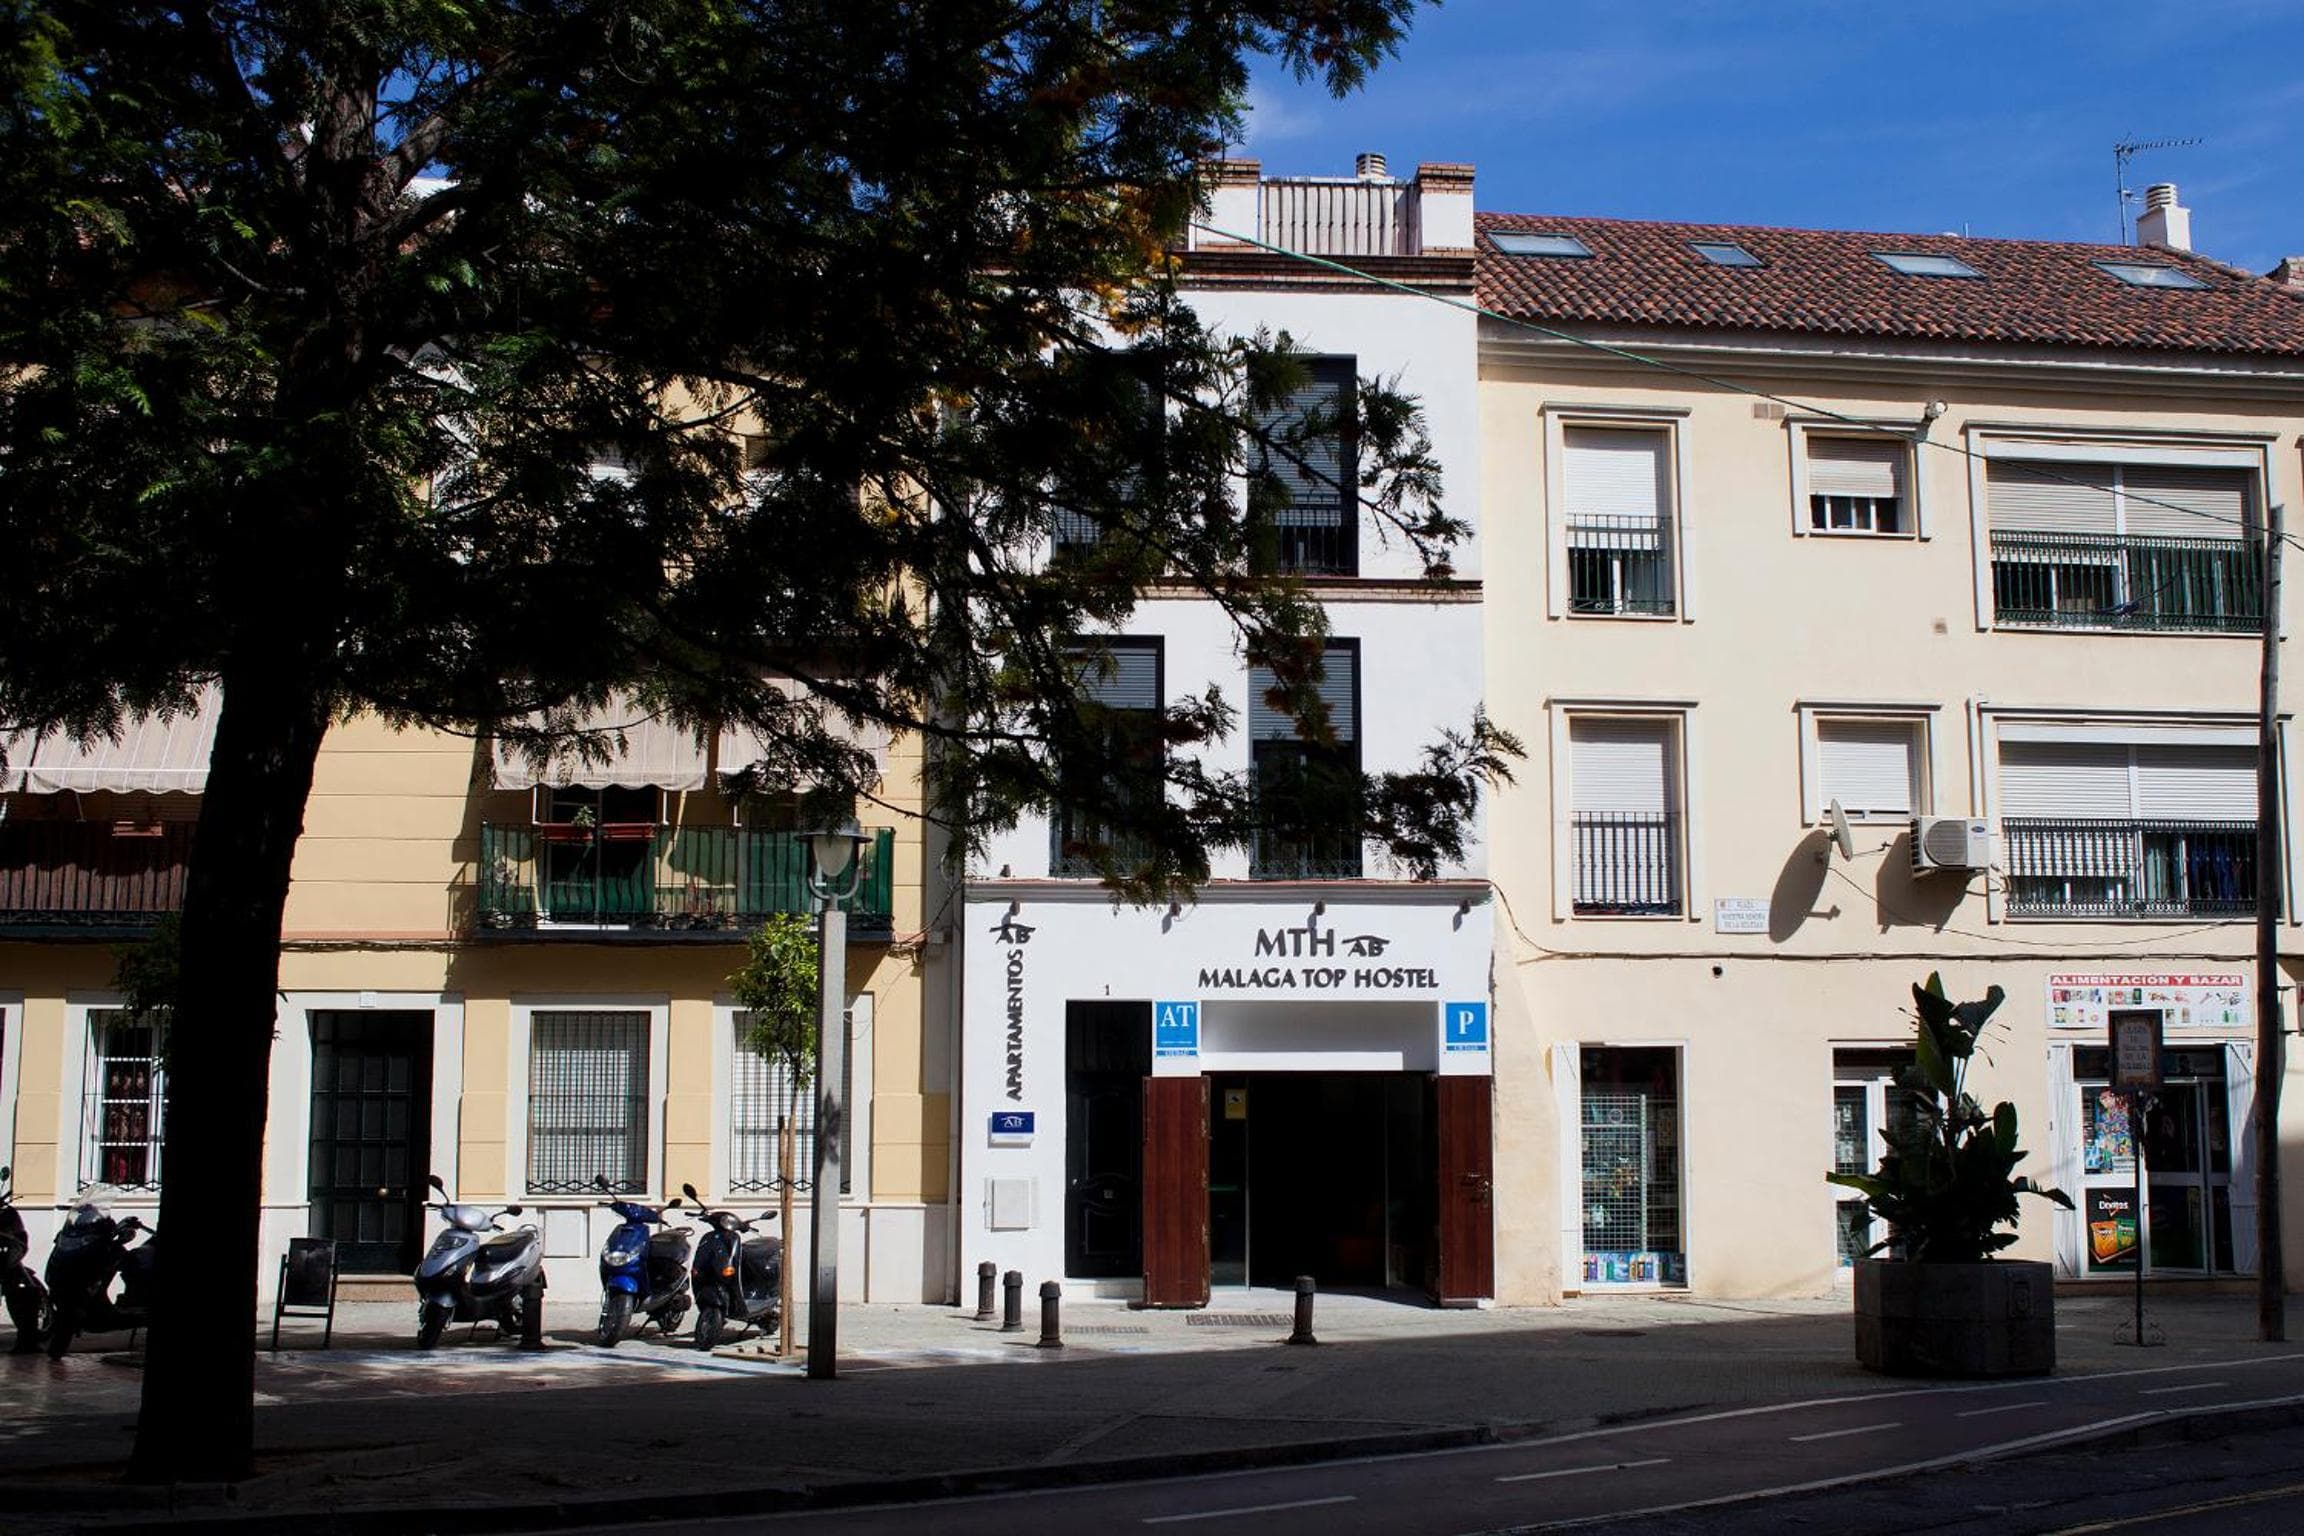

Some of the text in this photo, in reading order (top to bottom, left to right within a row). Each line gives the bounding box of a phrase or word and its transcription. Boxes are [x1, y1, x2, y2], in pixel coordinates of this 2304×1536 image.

[1255, 928, 1388, 957] MTH AB
[1198, 967, 1439, 988] MALAGA TOP HOSTEL
[2174, 975, 2185, 984] Y
[2190, 975, 2241, 984] BAZAR
[1006, 949, 1023, 1101] APARTAMENTOS
[1160, 1005, 1194, 1027] AT
[1458, 1010, 1474, 1035] P
[2098, 1200, 2129, 1210] Doritos
